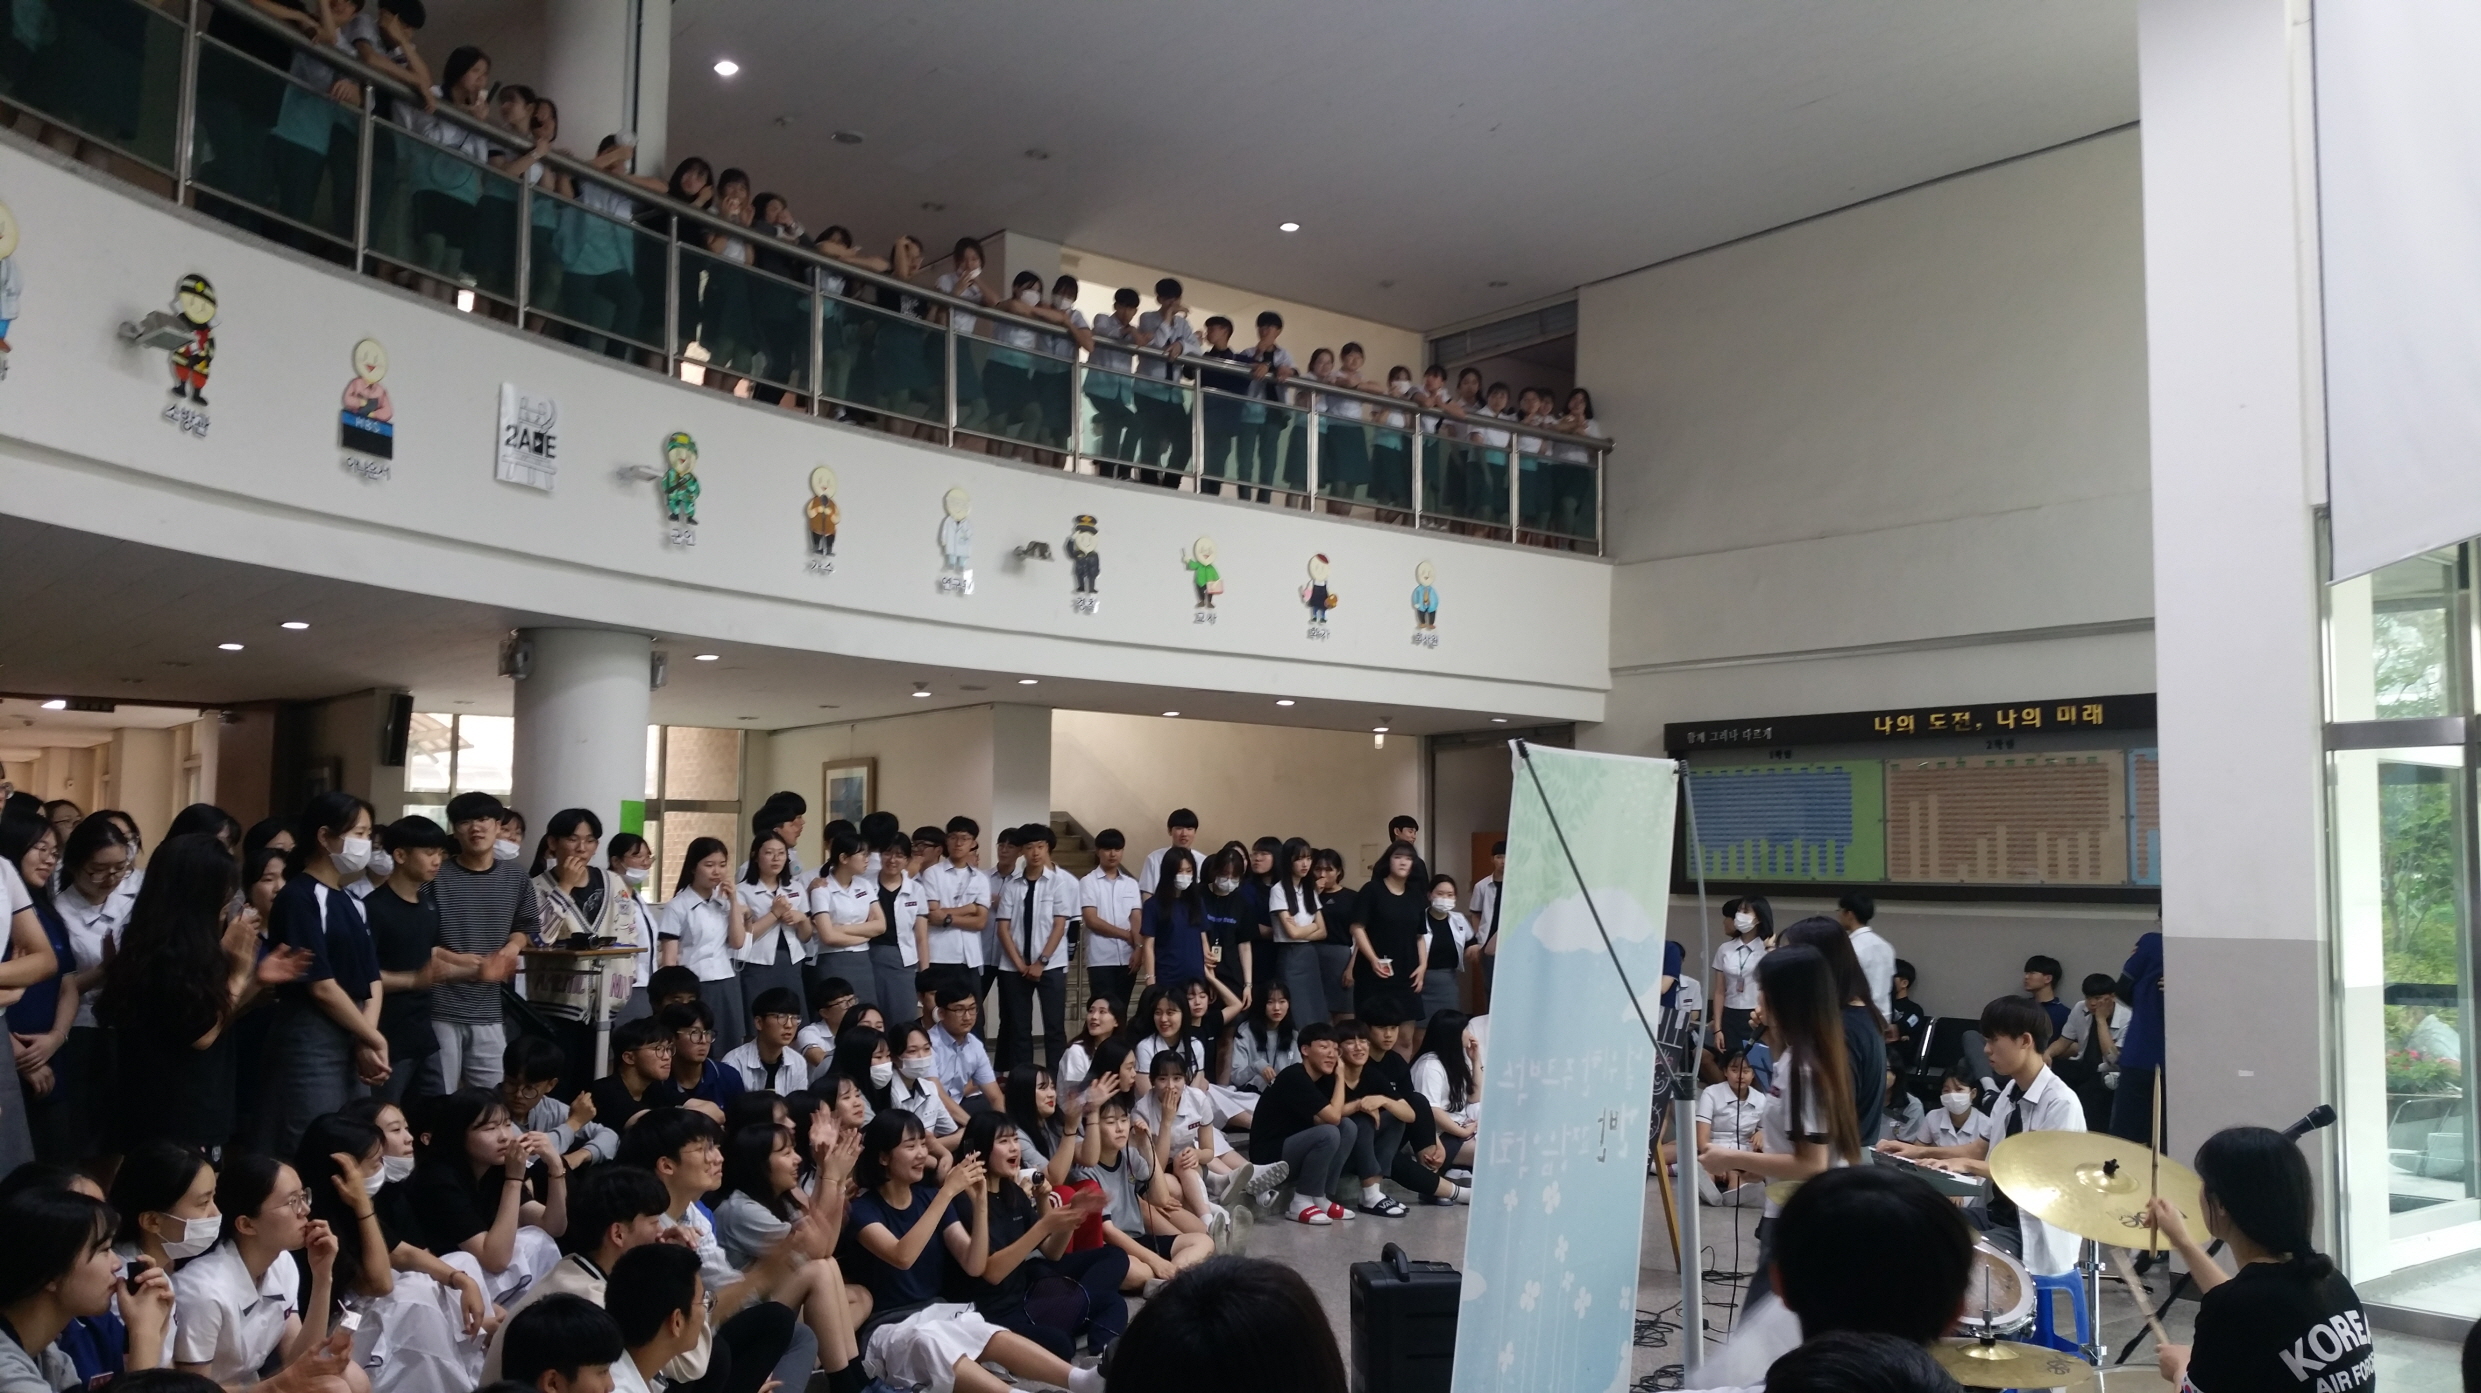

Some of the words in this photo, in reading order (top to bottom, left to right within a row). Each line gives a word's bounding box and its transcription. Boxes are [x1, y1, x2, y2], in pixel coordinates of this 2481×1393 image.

[164, 403, 210, 437] 소방관
[670, 528, 696, 546] 군인
[1874, 714, 1916, 736] 나의
[1928, 711, 1982, 732] 도전,
[1997, 706, 2042, 730] 나의
[2056, 703, 2104, 725] 미래
[1709, 728, 1739, 743] 그러나
[1742, 726, 1773, 741] 다르게
[2316, 1370, 2354, 1393] AIR
